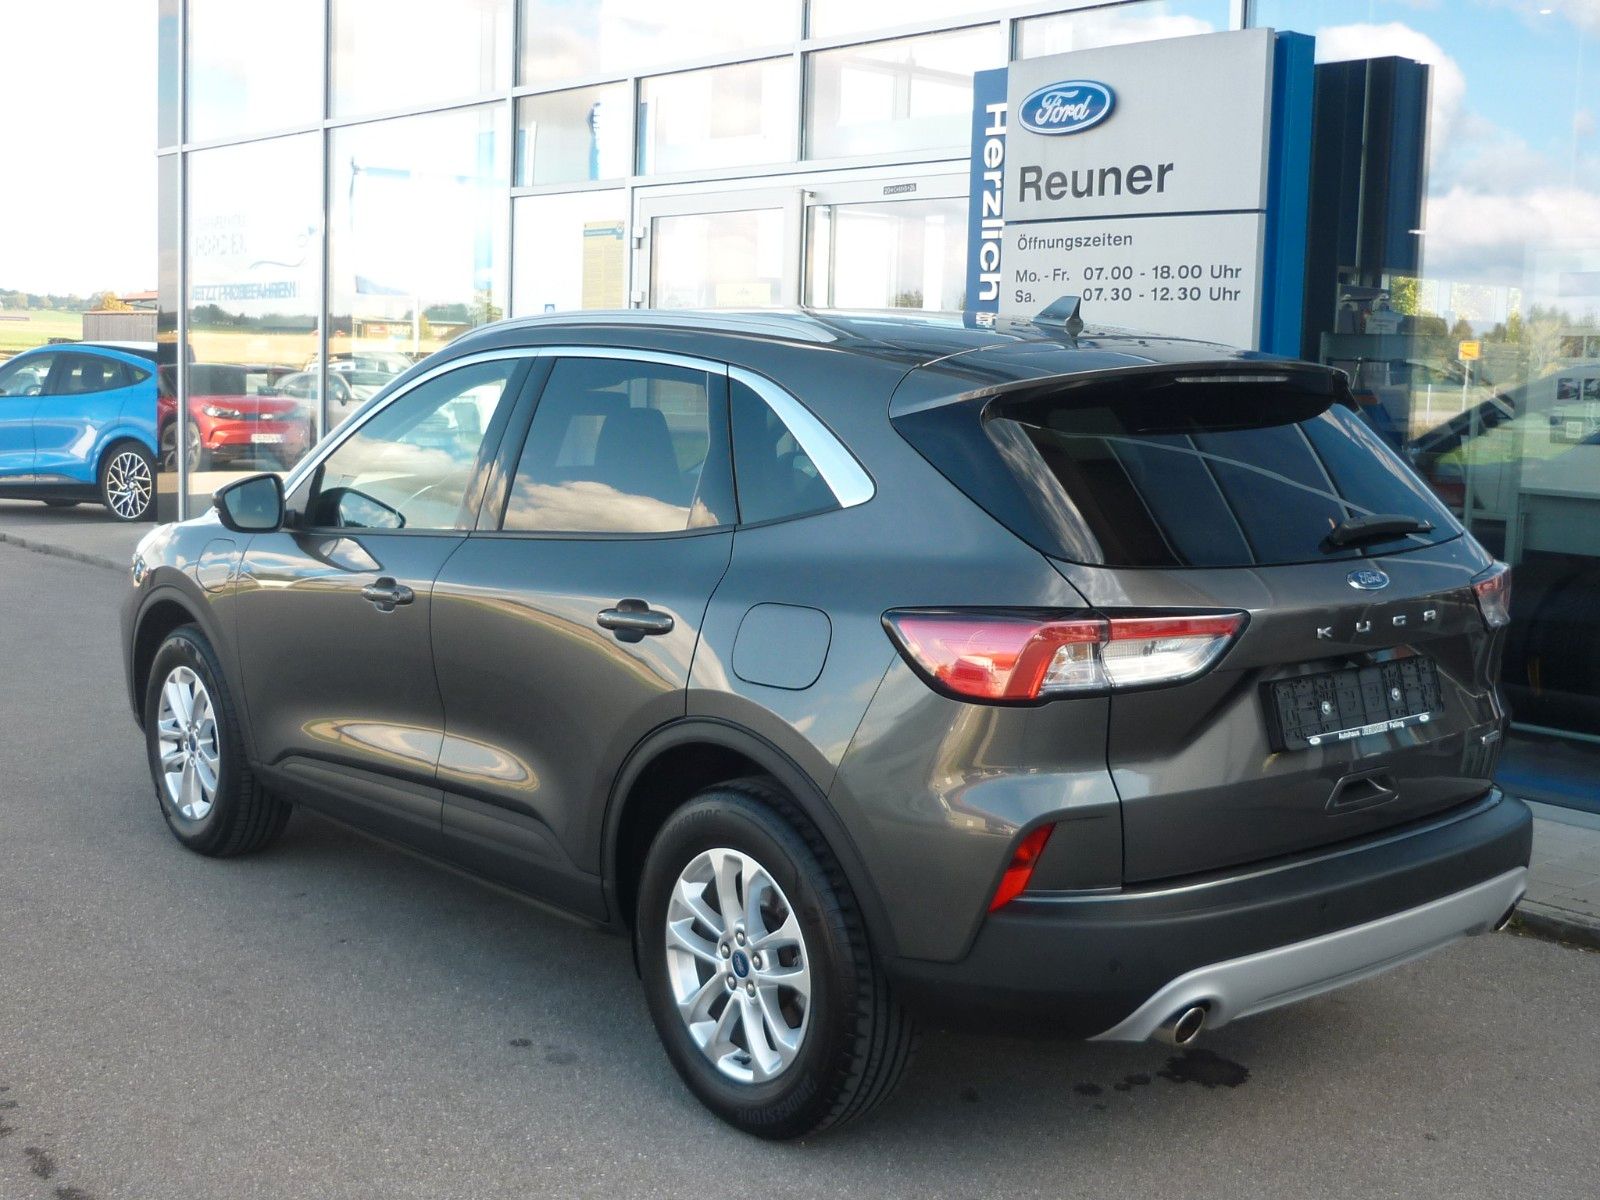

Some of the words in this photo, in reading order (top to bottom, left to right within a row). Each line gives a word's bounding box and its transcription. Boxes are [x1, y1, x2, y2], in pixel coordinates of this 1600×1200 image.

[1035, 90, 1094, 125] Ford
[1018, 162, 1174, 202] Reuner
[979, 102, 1007, 301] Herzlich
[1016, 233, 1133, 251] Öffnungszeiten
[1015, 270, 1041, 283] Mo.
[1052, 268, 1070, 282] Fr.
[1083, 266, 1133, 281] 07.00
[1151, 264, 1202, 280] 18.00
[1209, 264, 1242, 280] Uhr
[1015, 290, 1036, 303] Sa.
[1082, 287, 1133, 302] 07.30
[1150, 287, 1202, 302] 12.30
[1208, 286, 1241, 302] Uhr
[1317, 609, 1436, 639] KUGA
